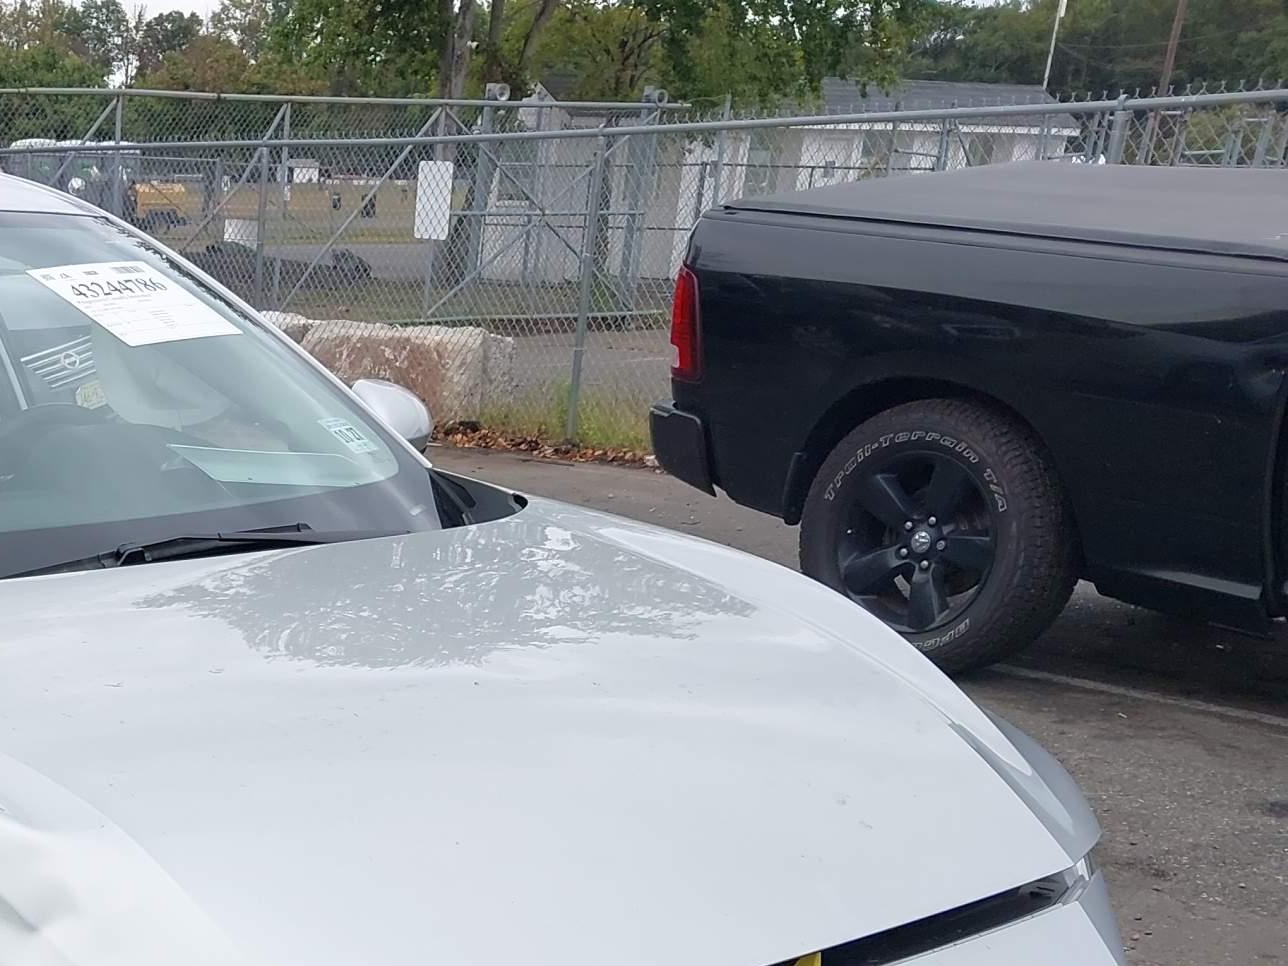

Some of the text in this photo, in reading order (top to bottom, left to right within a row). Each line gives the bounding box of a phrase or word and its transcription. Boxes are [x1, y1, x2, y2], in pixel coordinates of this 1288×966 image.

[70, 277, 168, 298] 43244786
[824, 430, 1008, 514] Trail-Terrain T/A
